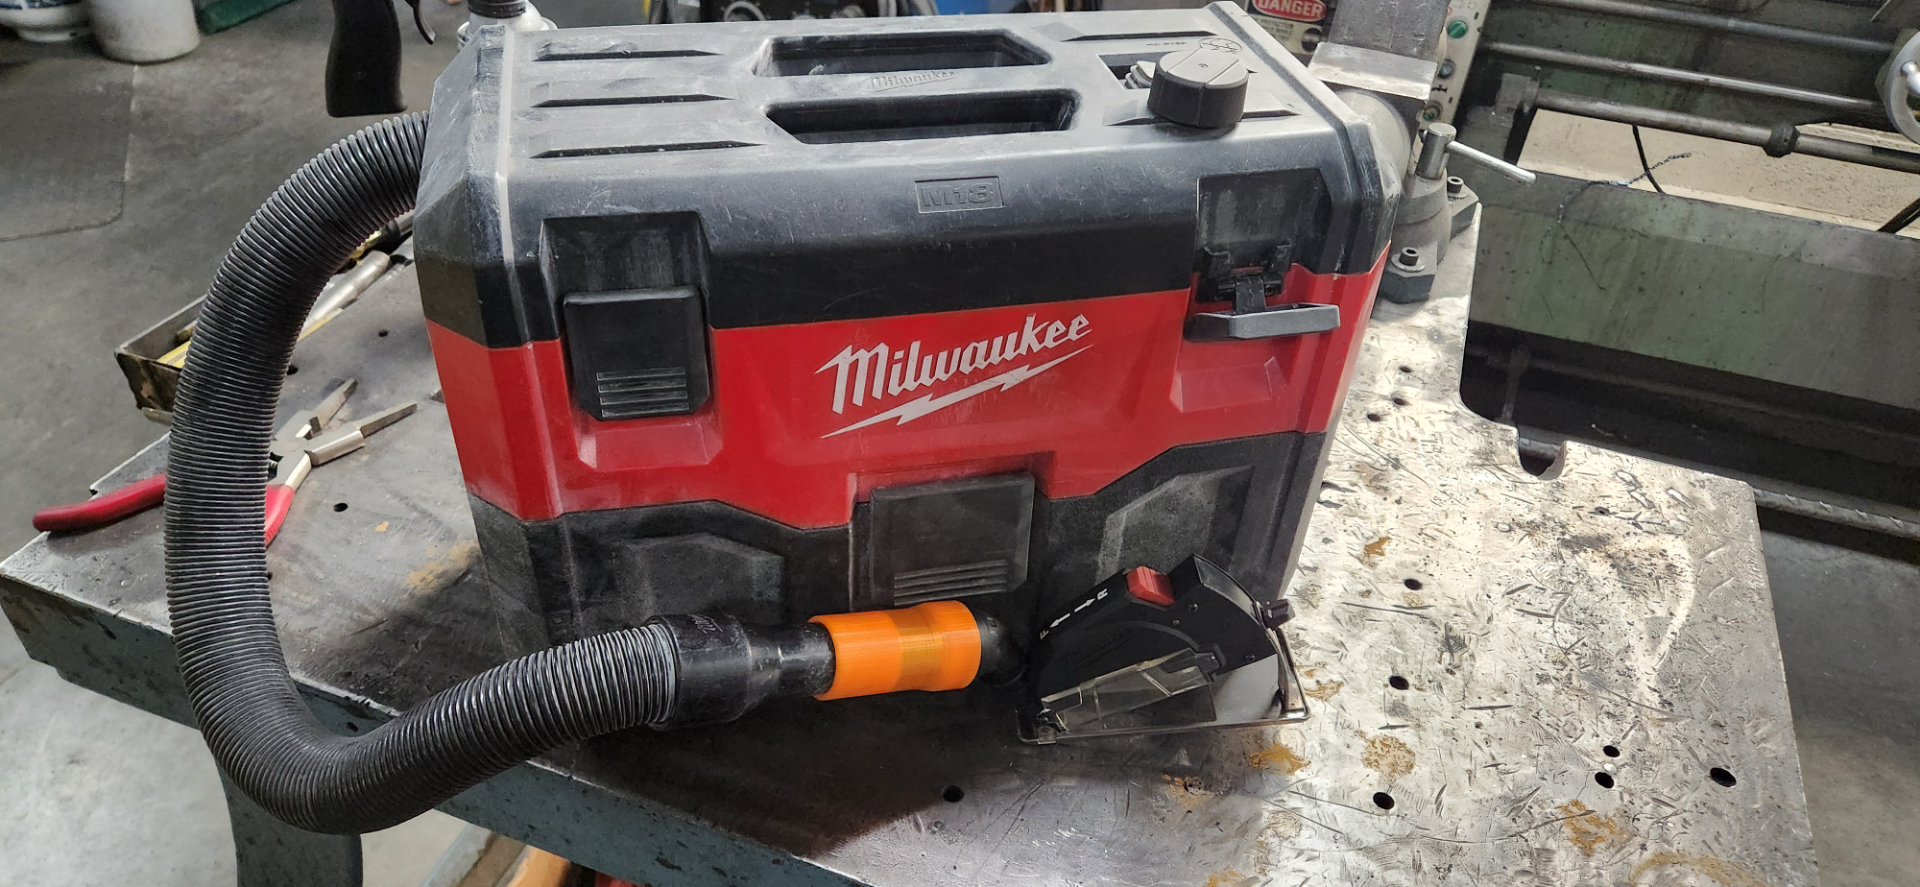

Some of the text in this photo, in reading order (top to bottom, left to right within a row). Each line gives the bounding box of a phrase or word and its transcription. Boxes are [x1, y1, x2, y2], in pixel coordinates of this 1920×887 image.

[1257, 0, 1323, 18] DANGER
[866, 71, 956, 89] Milwaukee
[920, 183, 996, 207] M18
[814, 313, 1093, 415] Milwaukee
[1096, 588, 1109, 601] R
